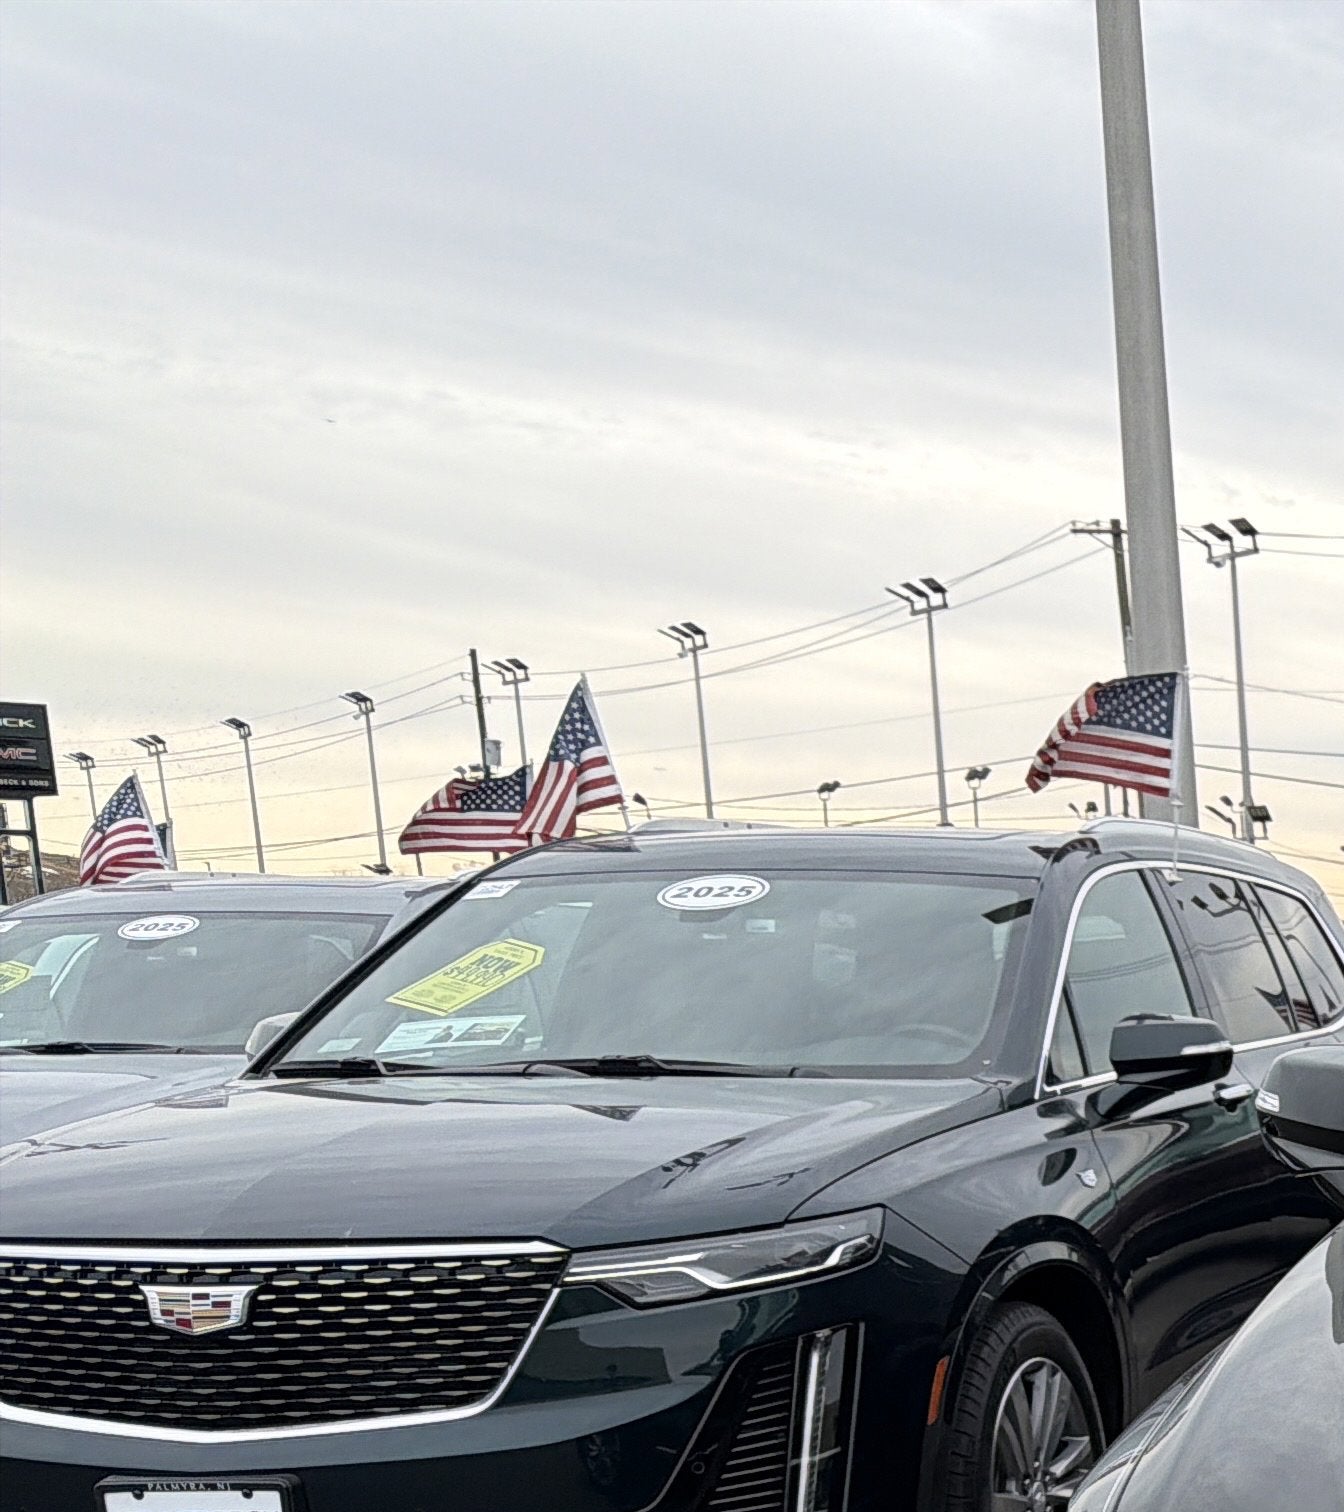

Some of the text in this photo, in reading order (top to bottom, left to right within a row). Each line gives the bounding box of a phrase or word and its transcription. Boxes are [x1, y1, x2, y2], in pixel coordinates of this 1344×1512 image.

[669, 885, 757, 899] 2025
[128, 922, 189, 932] 2025
[468, 953, 522, 975] NOW
[216, 1482, 231, 1491] NJ
